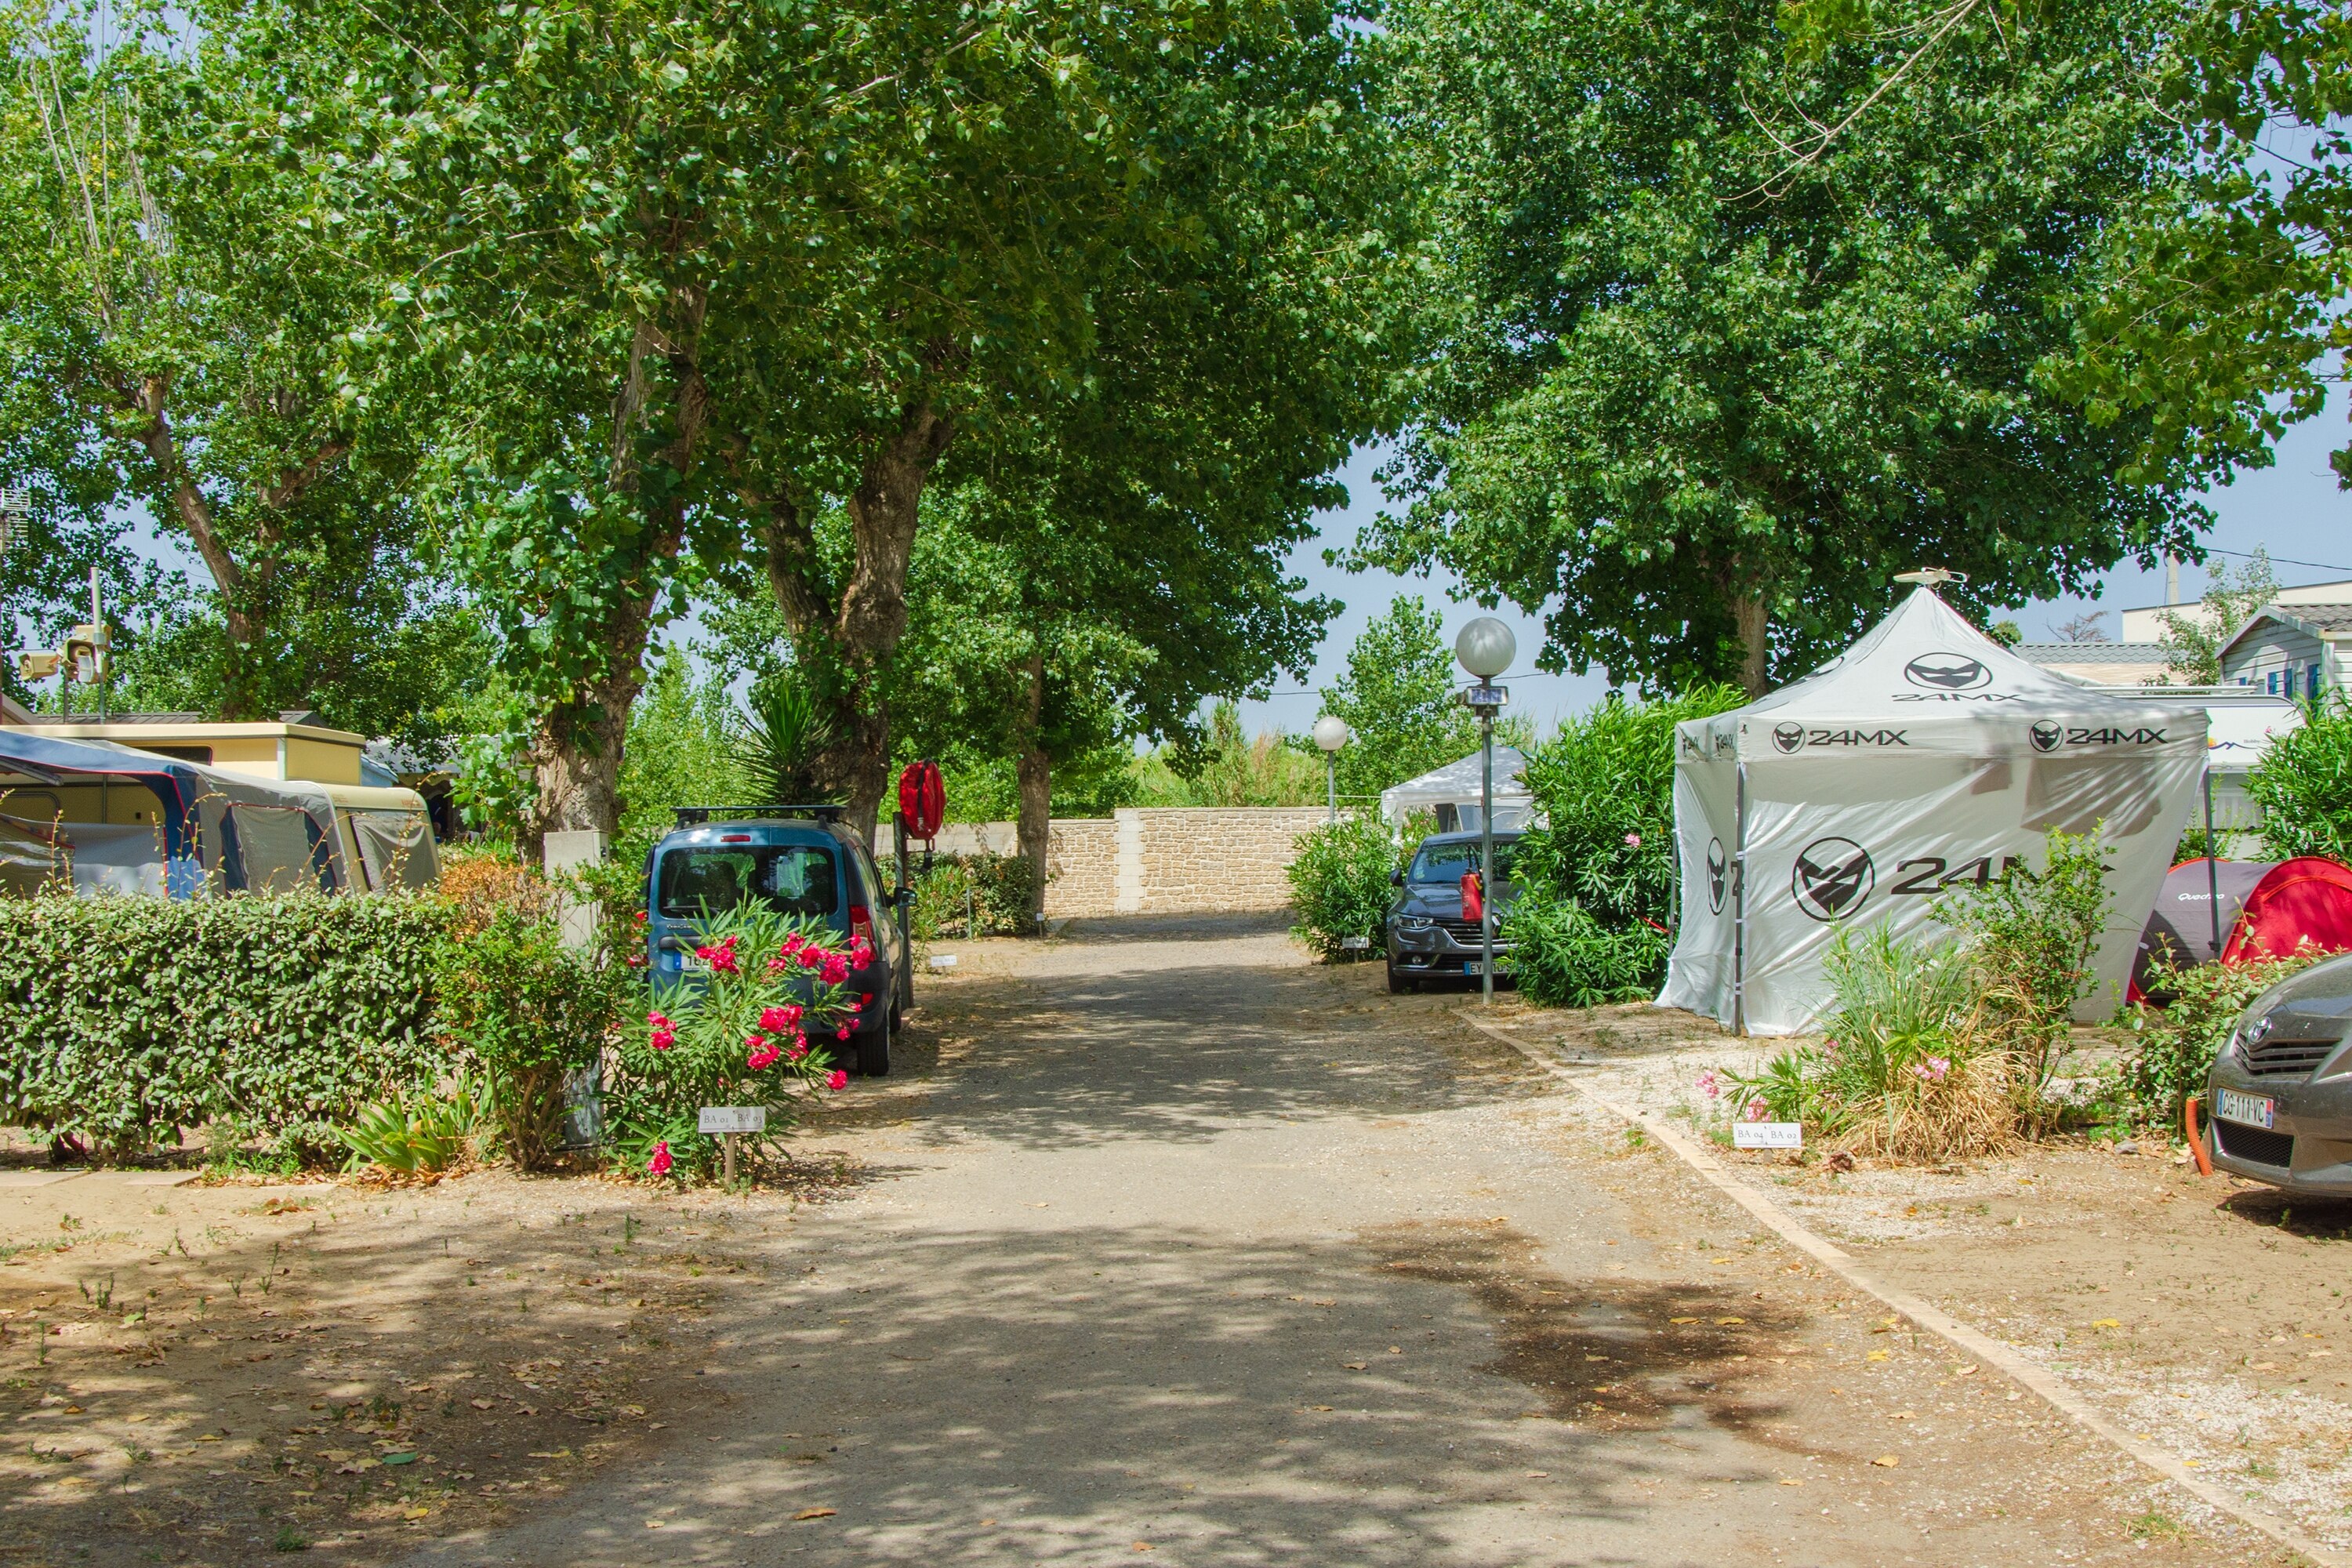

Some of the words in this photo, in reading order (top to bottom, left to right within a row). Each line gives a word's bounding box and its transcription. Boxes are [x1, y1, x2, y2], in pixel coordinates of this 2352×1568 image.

[1891, 693, 2029, 702] 24MX
[1808, 729, 1910, 746] 24MX
[2066, 728, 2169, 744] 24MX
[704, 1115, 717, 1123] BA
[738, 1113, 750, 1122] BA
[1738, 1130, 1751, 1138] BA
[1771, 1131, 1784, 1139] BA
